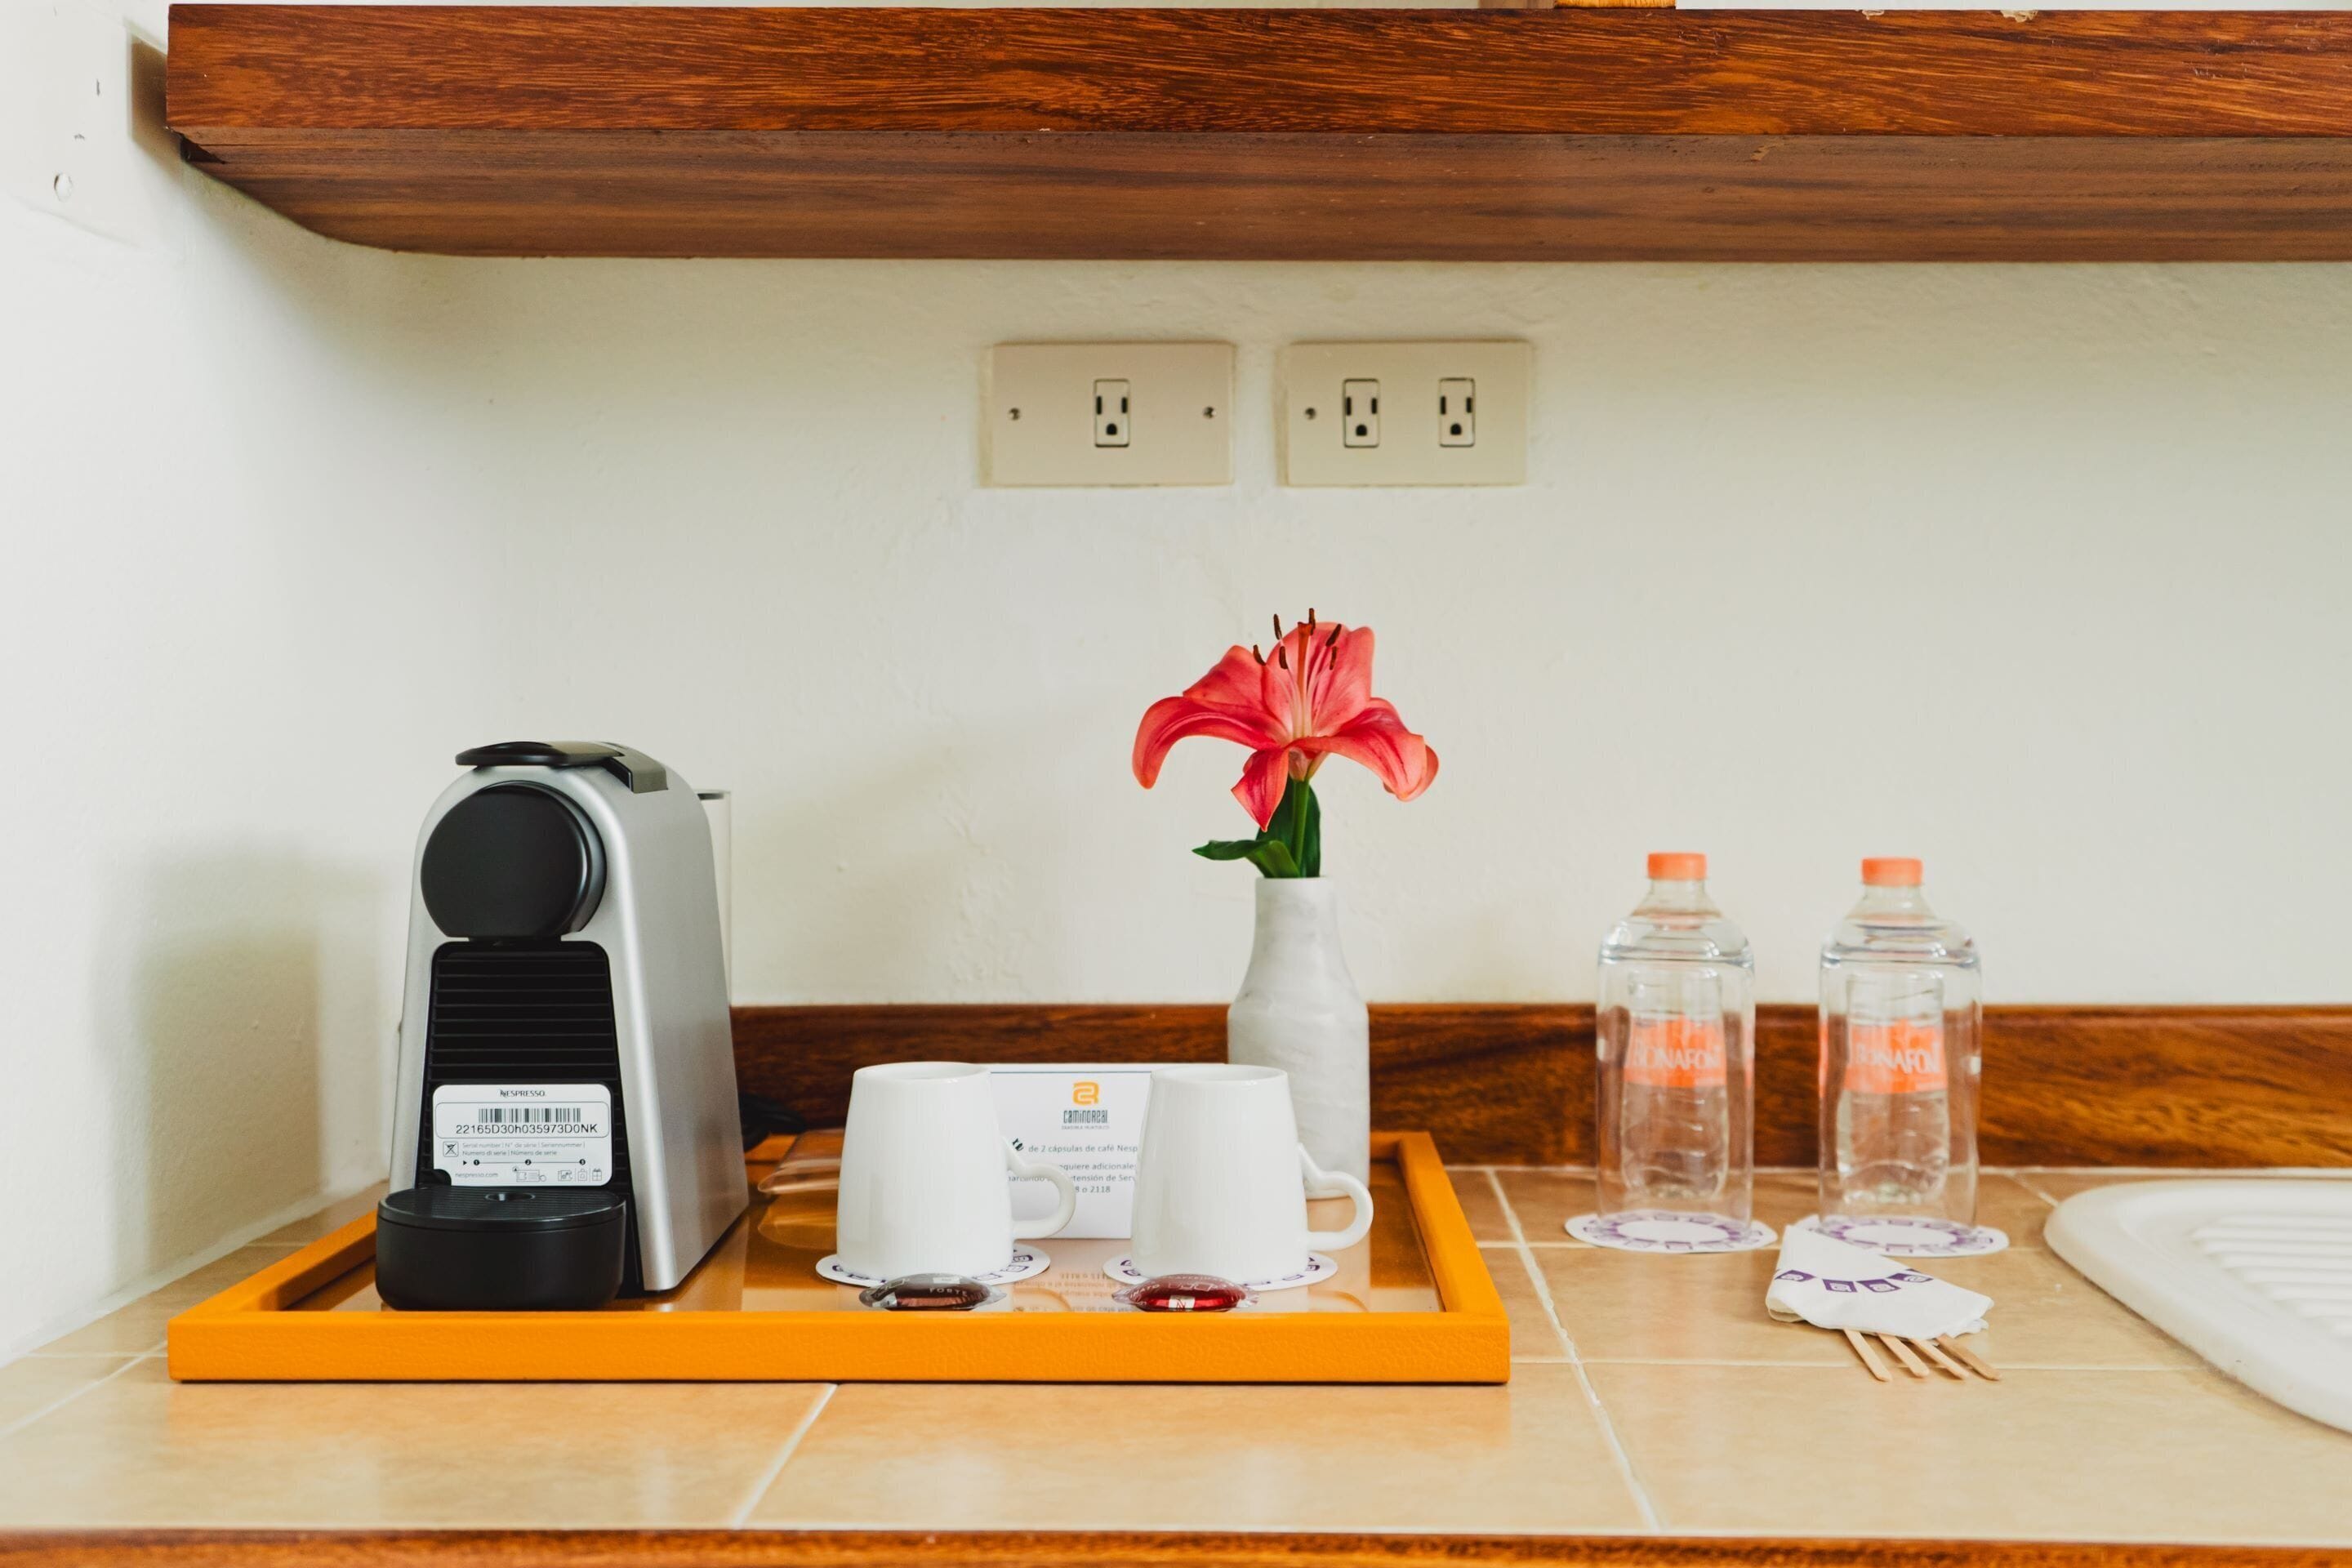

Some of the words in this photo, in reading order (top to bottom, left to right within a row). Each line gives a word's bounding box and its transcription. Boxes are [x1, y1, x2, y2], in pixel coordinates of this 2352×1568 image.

[499, 1089, 546, 1098] NESPRESSO
[1048, 1144, 1083, 1154] cápsulas
[1085, 1144, 1096, 1152] de
[1098, 1144, 1115, 1152] café
[1106, 1174, 1117, 1182] de
[1090, 1185, 1111, 1193] 2118
[929, 1287, 968, 1297] FORTE
